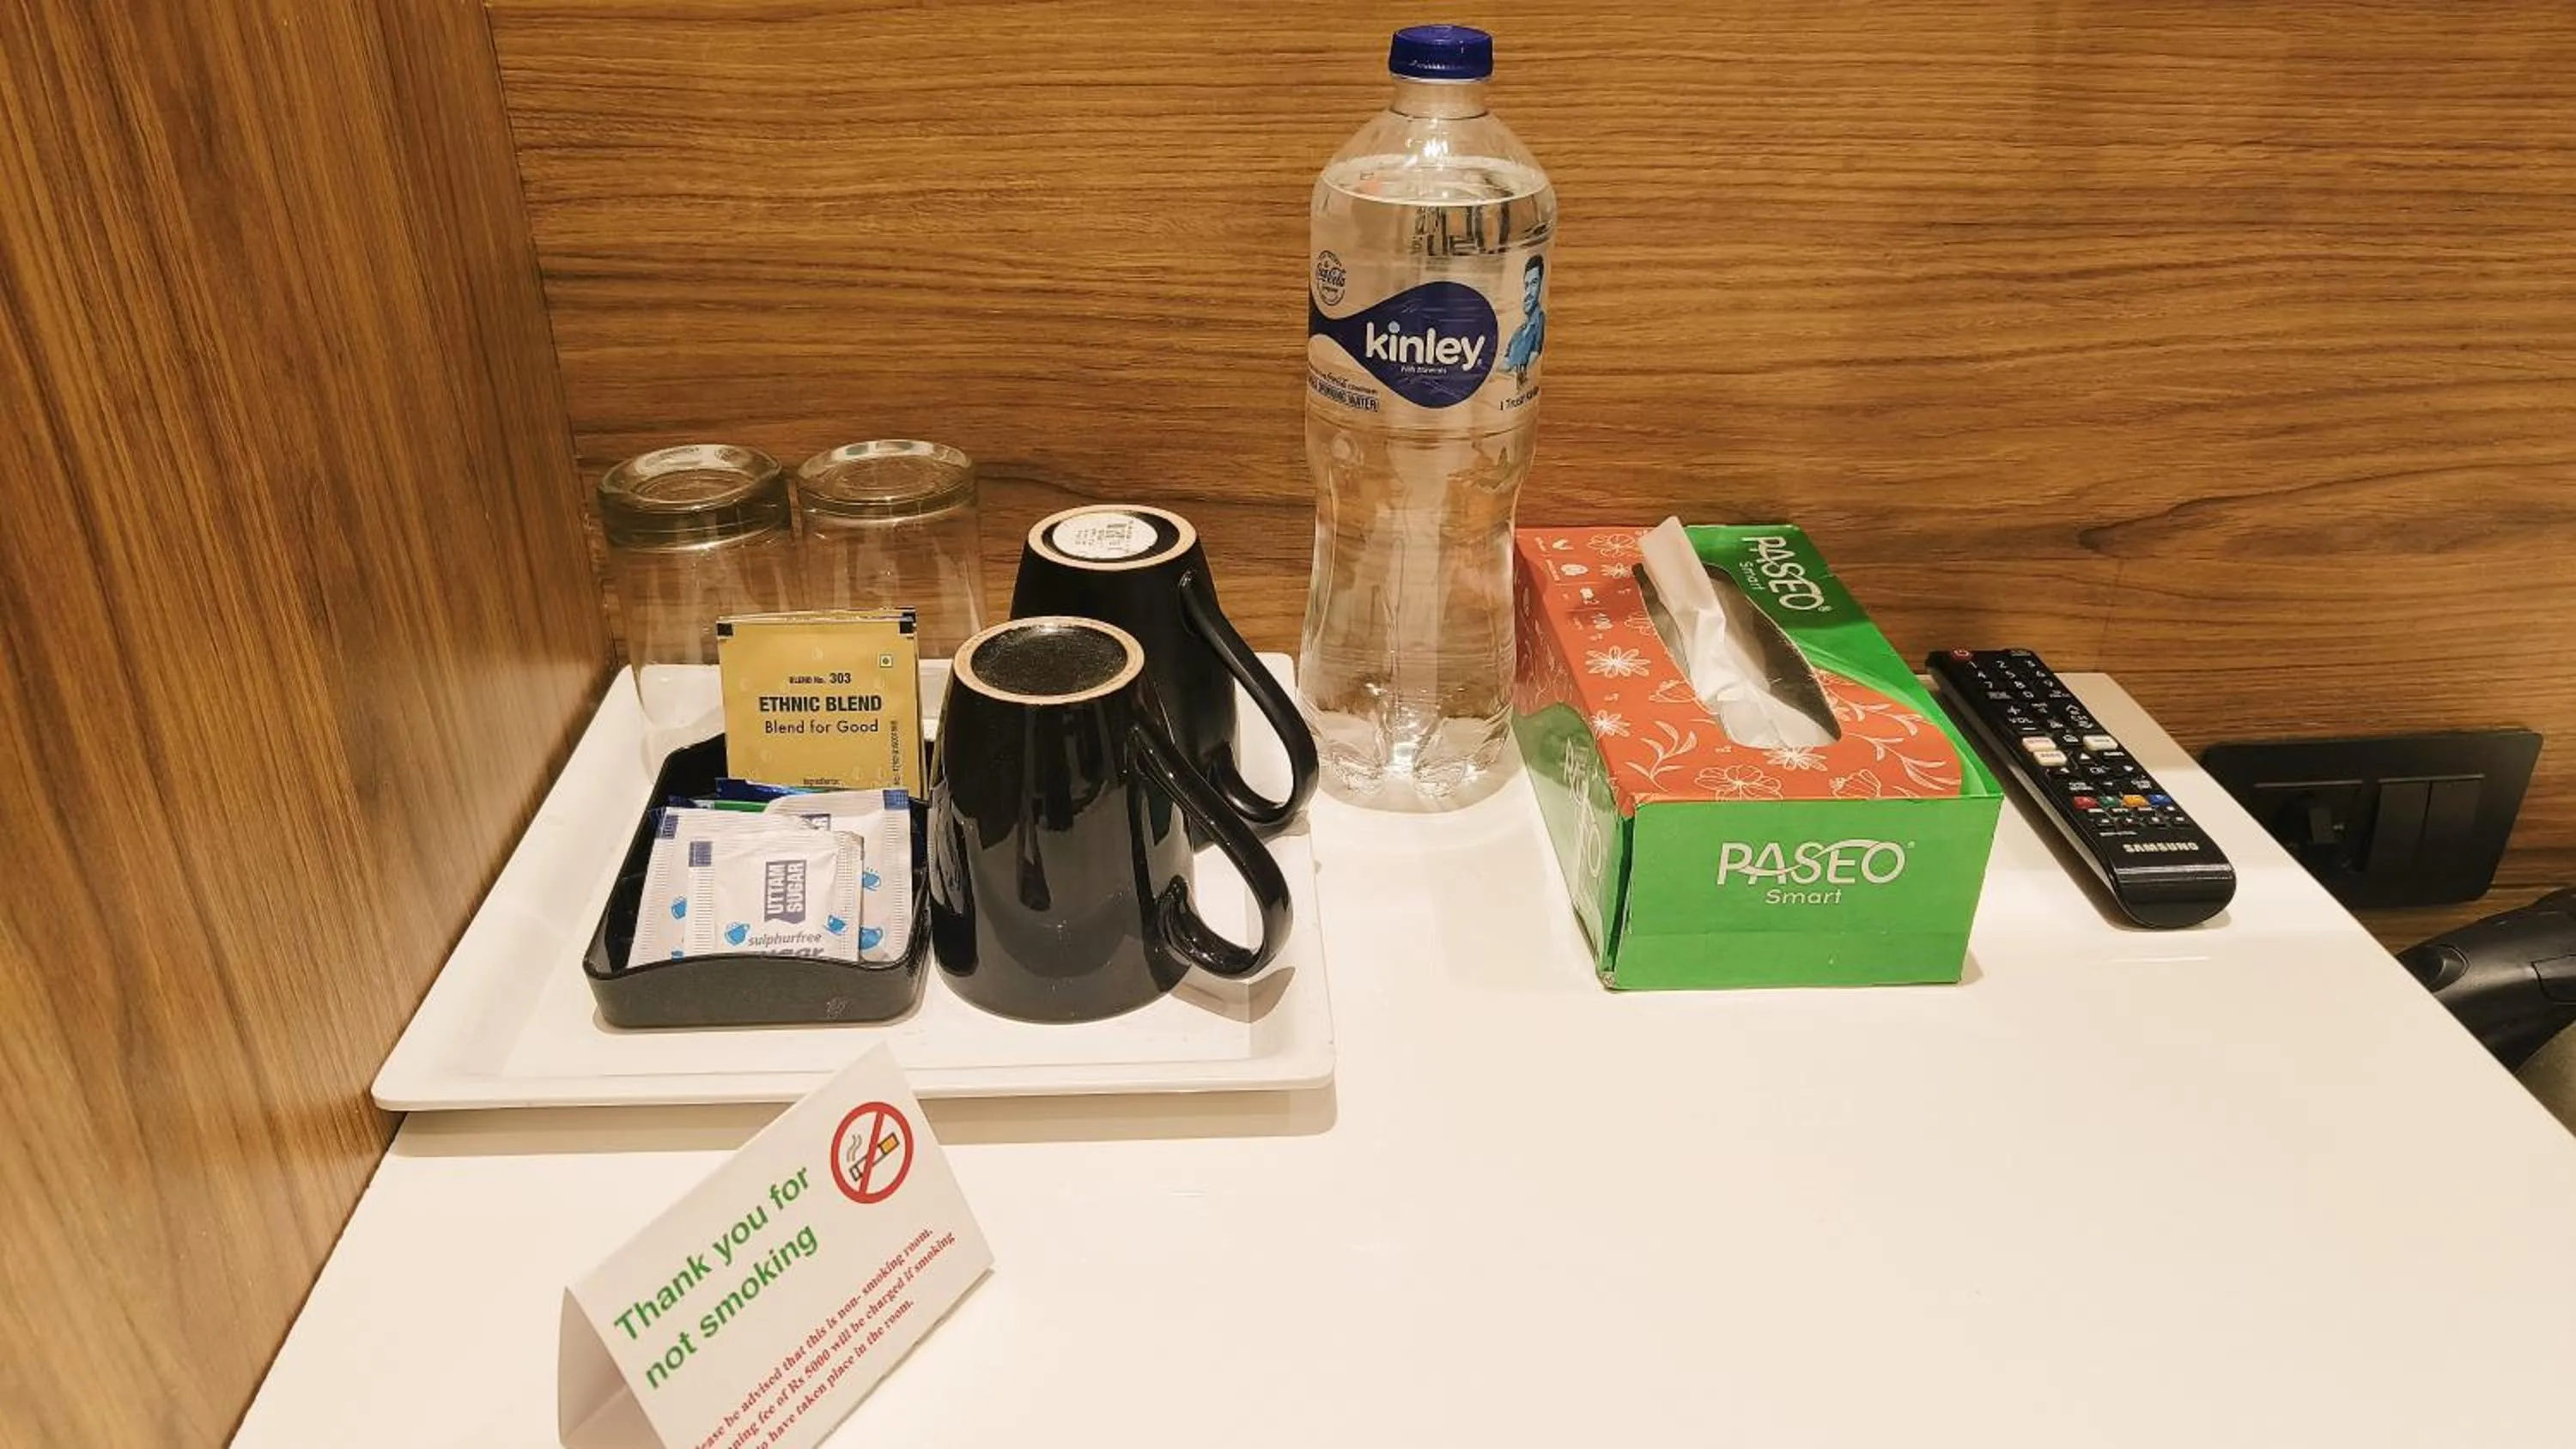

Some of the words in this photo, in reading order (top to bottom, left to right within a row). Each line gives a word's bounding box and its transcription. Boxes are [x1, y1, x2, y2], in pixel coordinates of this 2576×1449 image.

[1365, 320, 1485, 371] kinley
[1739, 561, 1765, 590] Smart
[1741, 537, 1824, 610] PASEO
[829, 672, 851, 684] 303
[759, 696, 820, 712] ETHNIC
[825, 695, 882, 712] BLEND
[765, 720, 805, 734] Blend
[810, 720, 830, 733] for
[836, 719, 879, 733] Good
[1716, 838, 1905, 887] PASEO
[2123, 842, 2199, 852] SAMSUNG
[767, 864, 786, 914] UTTAM
[787, 862, 804, 913] SUGAR
[1765, 888, 1841, 905] Smart
[748, 931, 822, 948] sulphurfree
[614, 1252, 712, 1341] Thank
[712, 1205, 769, 1265] you
[769, 1167, 811, 1210] for
[643, 1331, 698, 1390] not
[699, 1224, 818, 1339] smoking
[758, 1405, 776, 1424] fee
[776, 1388, 790, 1406] of
[787, 1377, 805, 1394] Rs
[804, 1349, 831, 1379] 5000
[831, 1328, 853, 1352] will
[850, 1317, 866, 1333] be
[866, 1276, 905, 1319] charged
[903, 1266, 914, 1282] if
[914, 1232, 956, 1274] smoking
[723, 1410, 740, 1428] be
[741, 1367, 783, 1412] advised
[781, 1345, 806, 1371] that
[806, 1325, 828, 1349] this
[826, 1315, 838, 1329] is
[861, 1253, 906, 1297] smoking
[768, 1414, 796, 1442] have
[796, 1384, 826, 1416] taken
[827, 1355, 854, 1388] place
[854, 1343, 866, 1358] in
[866, 1325, 884, 1346] the
